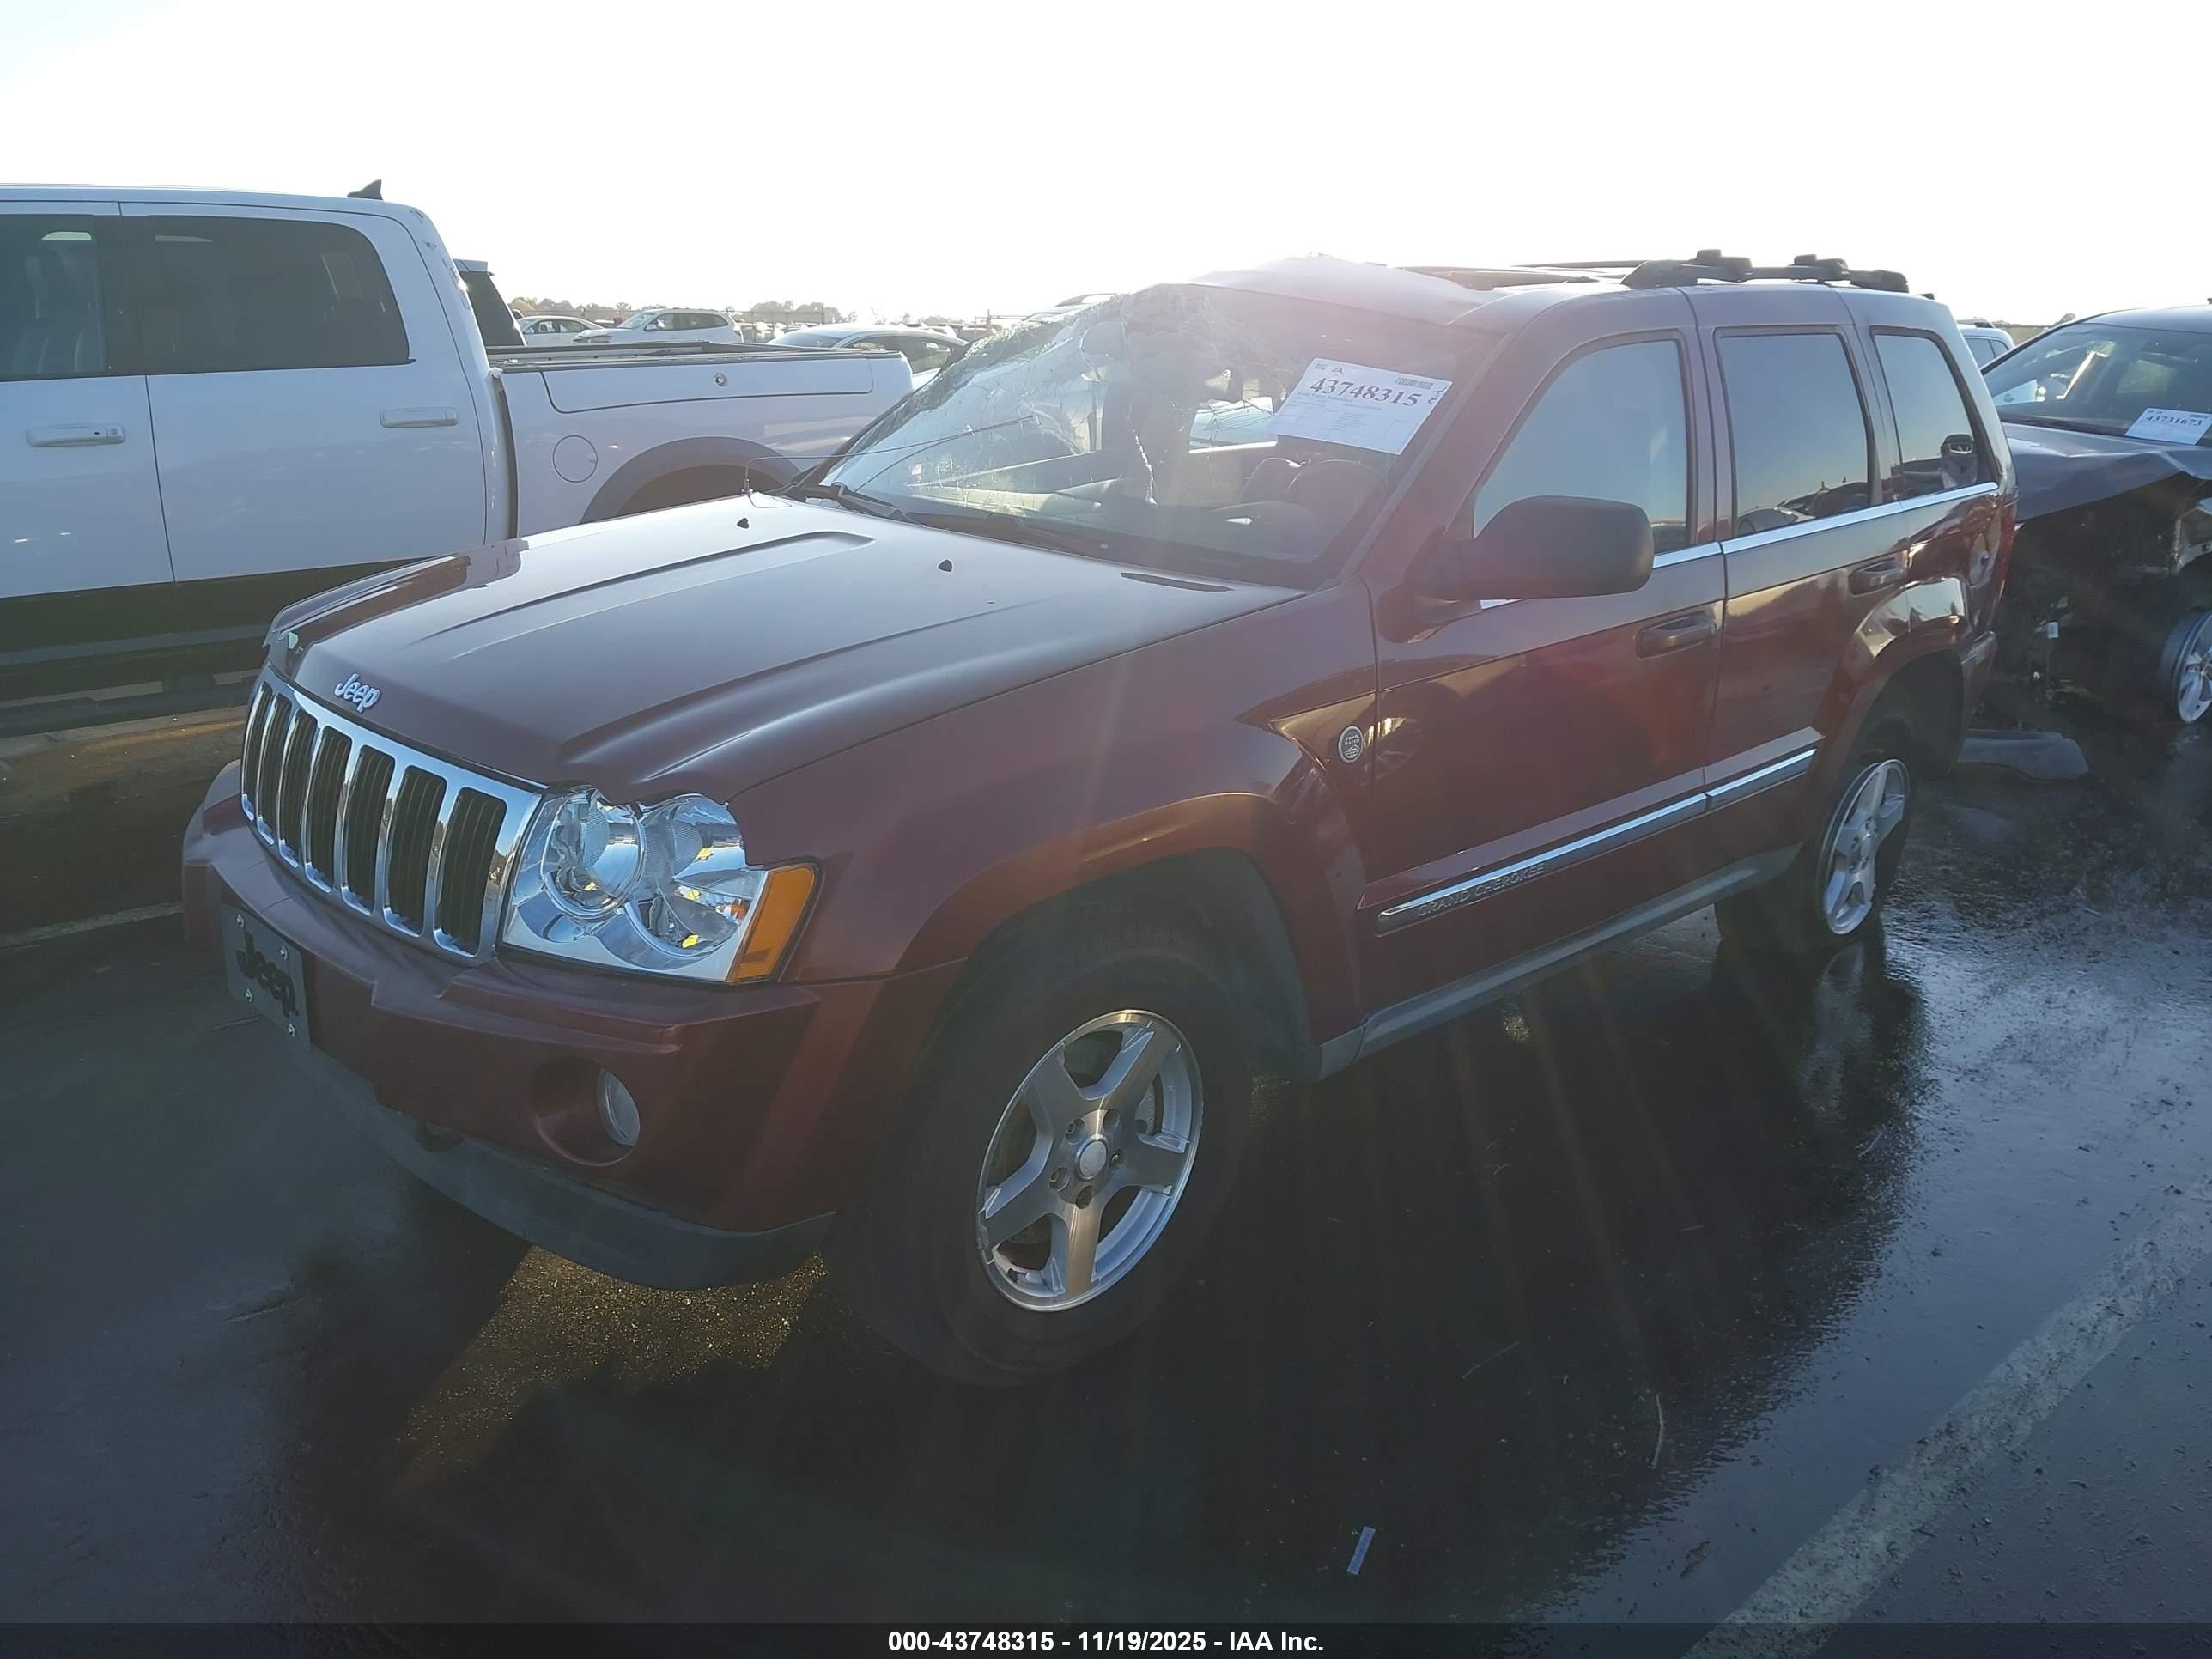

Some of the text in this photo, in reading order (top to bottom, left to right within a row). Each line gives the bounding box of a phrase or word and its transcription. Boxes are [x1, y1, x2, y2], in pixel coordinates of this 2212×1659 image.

[1310, 377, 1422, 406] 43748315
[334, 673, 380, 713] Jeep
[1417, 864, 1545, 916] GRAND CHEROKEE
